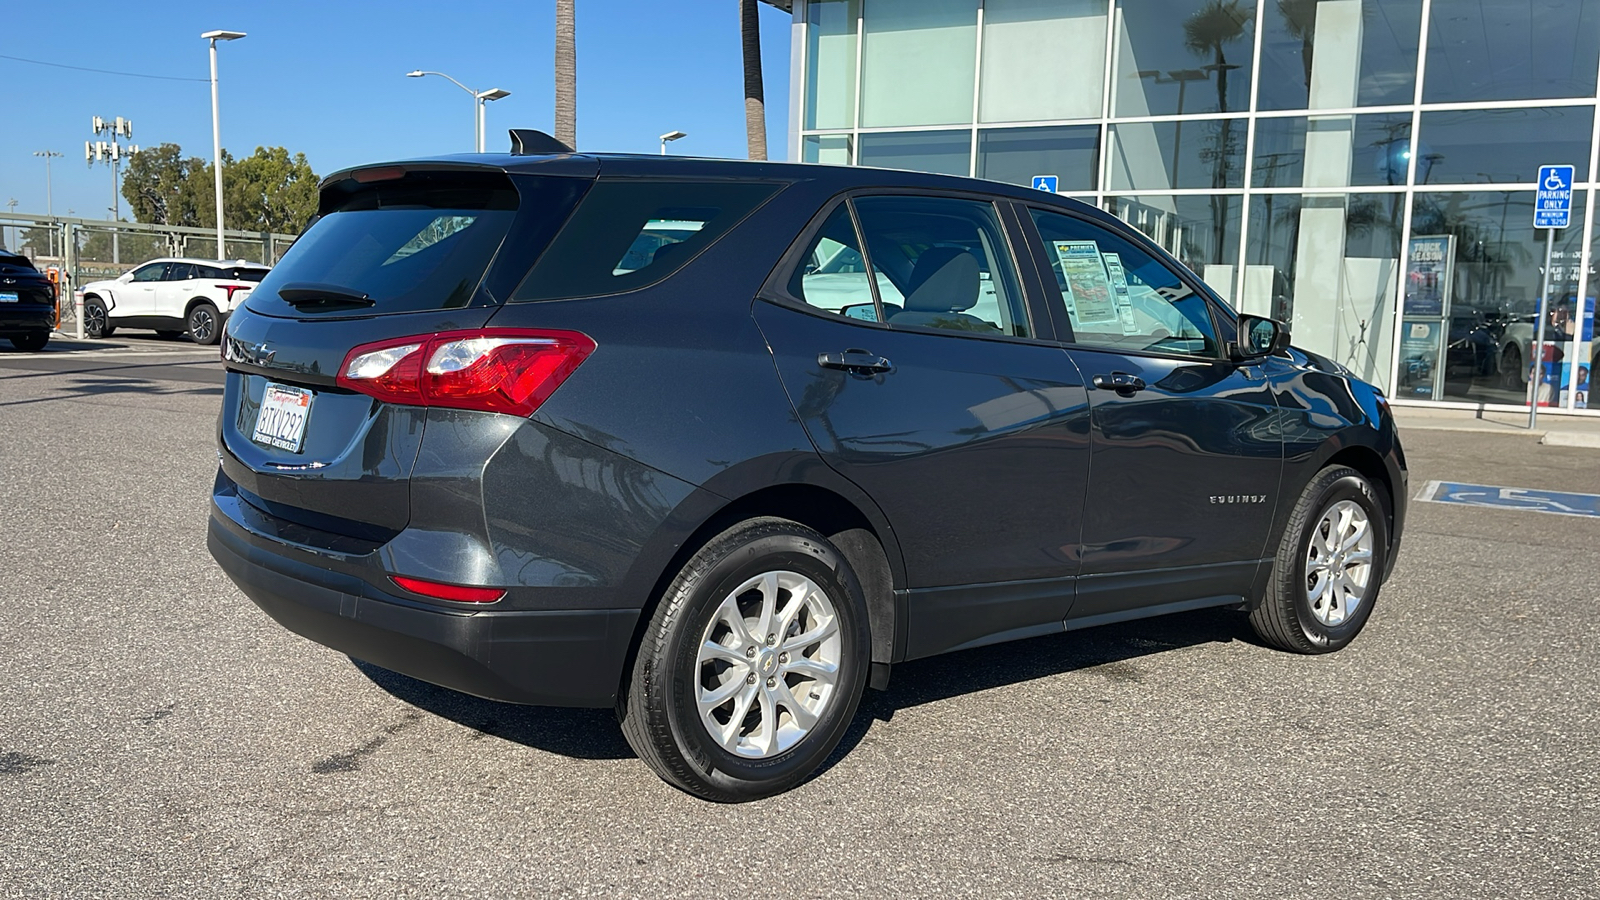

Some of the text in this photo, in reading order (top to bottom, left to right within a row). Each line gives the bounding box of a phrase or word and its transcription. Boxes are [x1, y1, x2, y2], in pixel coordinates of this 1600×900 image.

[1539, 190, 1569, 200] PARKING
[1543, 200, 1564, 209] ONLY
[1414, 242, 1441, 252] TRUCK
[1411, 251, 1442, 261] SEASON
[1538, 266, 1565, 275] YUR
[259, 407, 303, 442] 8TKV292
[255, 432, 297, 452] PREMIER CHEVROLET
[1209, 494, 1267, 504] EQUINOX
